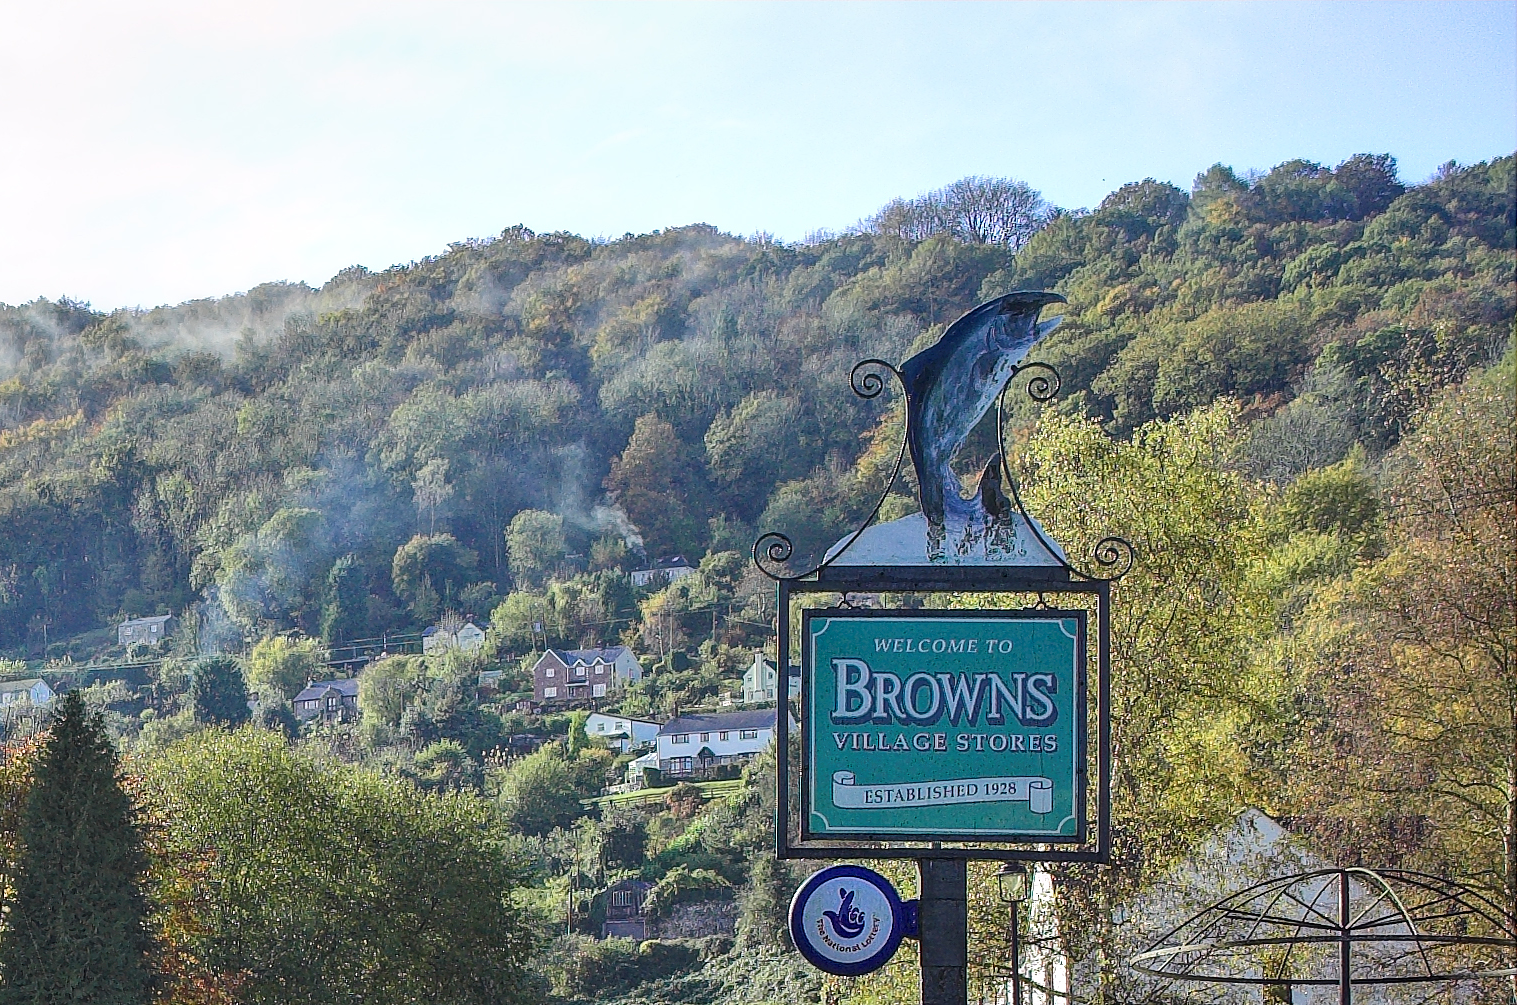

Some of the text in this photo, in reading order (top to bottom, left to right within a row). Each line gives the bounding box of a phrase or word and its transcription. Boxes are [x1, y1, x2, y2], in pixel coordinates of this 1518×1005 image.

[874, 638, 1013, 654] WELCOME TO
[832, 658, 1056, 725] BROWNS
[832, 732, 1058, 752] VILLAGE STORES
[864, 782, 1017, 804] ESTABLISHED 1928
[816, 914, 881, 953] The National Lottery
